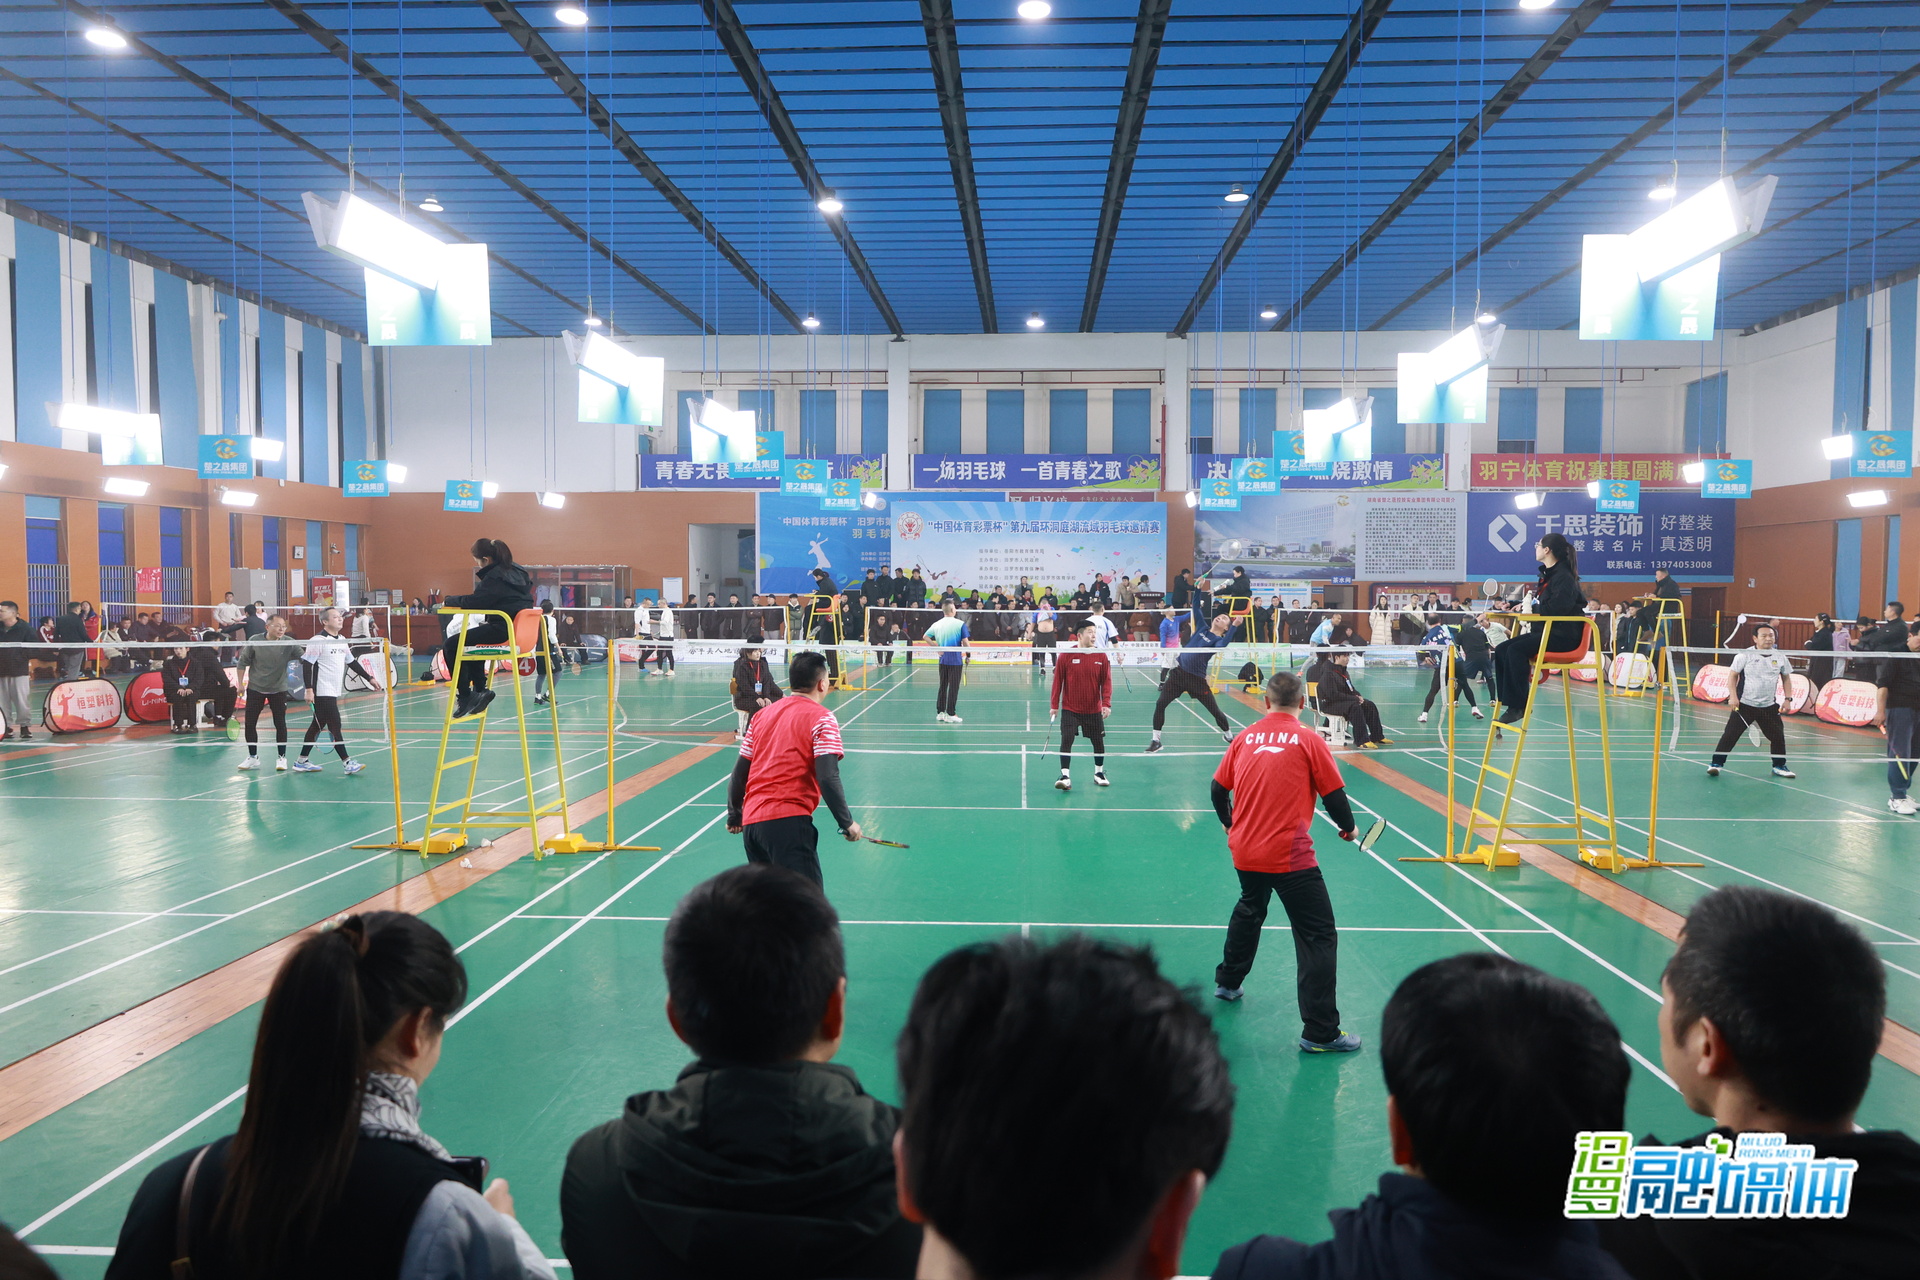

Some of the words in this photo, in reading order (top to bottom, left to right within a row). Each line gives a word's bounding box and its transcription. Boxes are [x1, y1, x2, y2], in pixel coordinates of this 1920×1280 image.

[922, 461, 1006, 480] 一场羽毛球
[1020, 461, 1122, 480] 一首青春之歌
[1309, 461, 1393, 481] 烧激情
[1536, 514, 1643, 536] 千思装饰
[1661, 514, 1712, 531] 好整装
[852, 529, 891, 538] 羽毛球
[1573, 540, 1643, 552] 整装名片
[1660, 536, 1712, 552] 真透明
[519, 656, 530, 673] 4
[77, 694, 115, 709] 恒塑科技
[1839, 694, 1875, 709] 恒塑科技
[1245, 732, 1299, 745] CHINA
